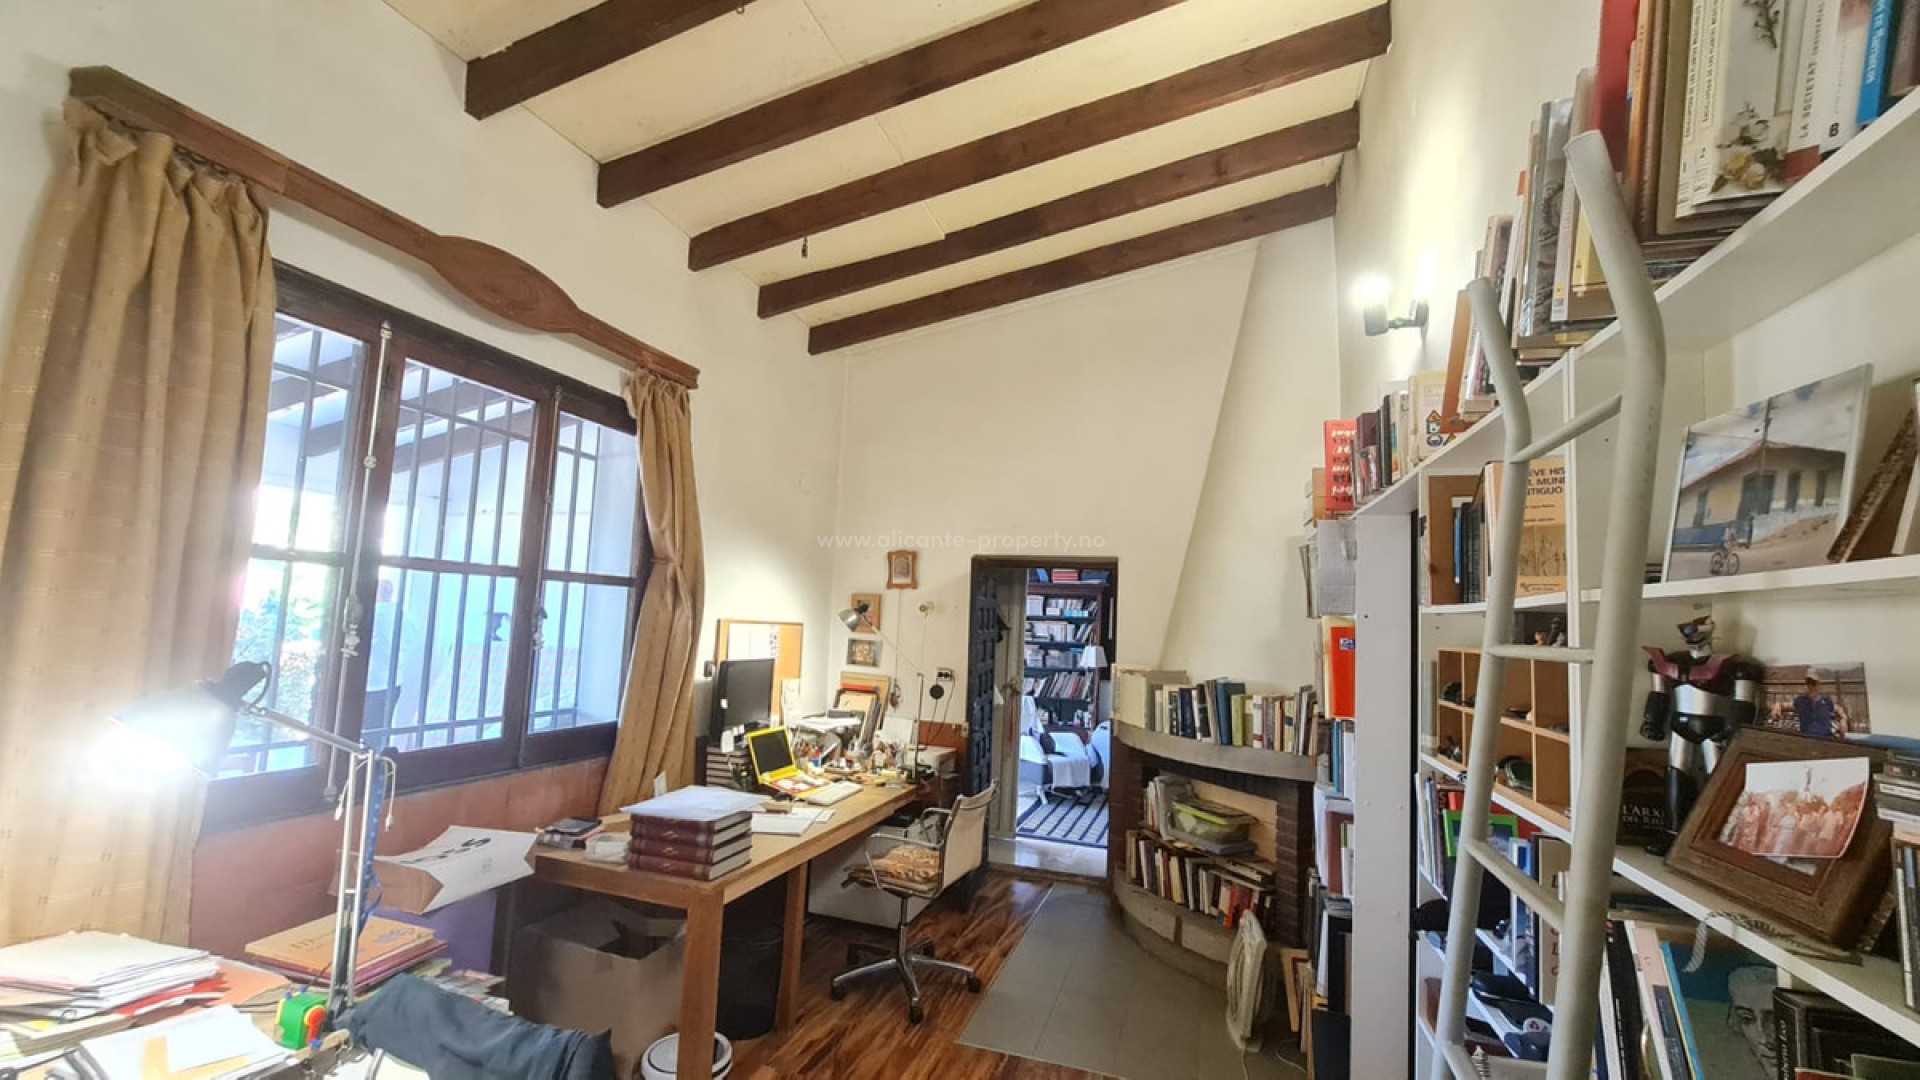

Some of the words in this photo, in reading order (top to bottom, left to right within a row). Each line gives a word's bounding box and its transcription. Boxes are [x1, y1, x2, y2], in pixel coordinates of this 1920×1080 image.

[1802, 61, 1817, 118] SOCIETAT
[1799, 123, 1809, 138] LA
[1828, 121, 1840, 138] B
[1549, 466, 1565, 475] HIS
